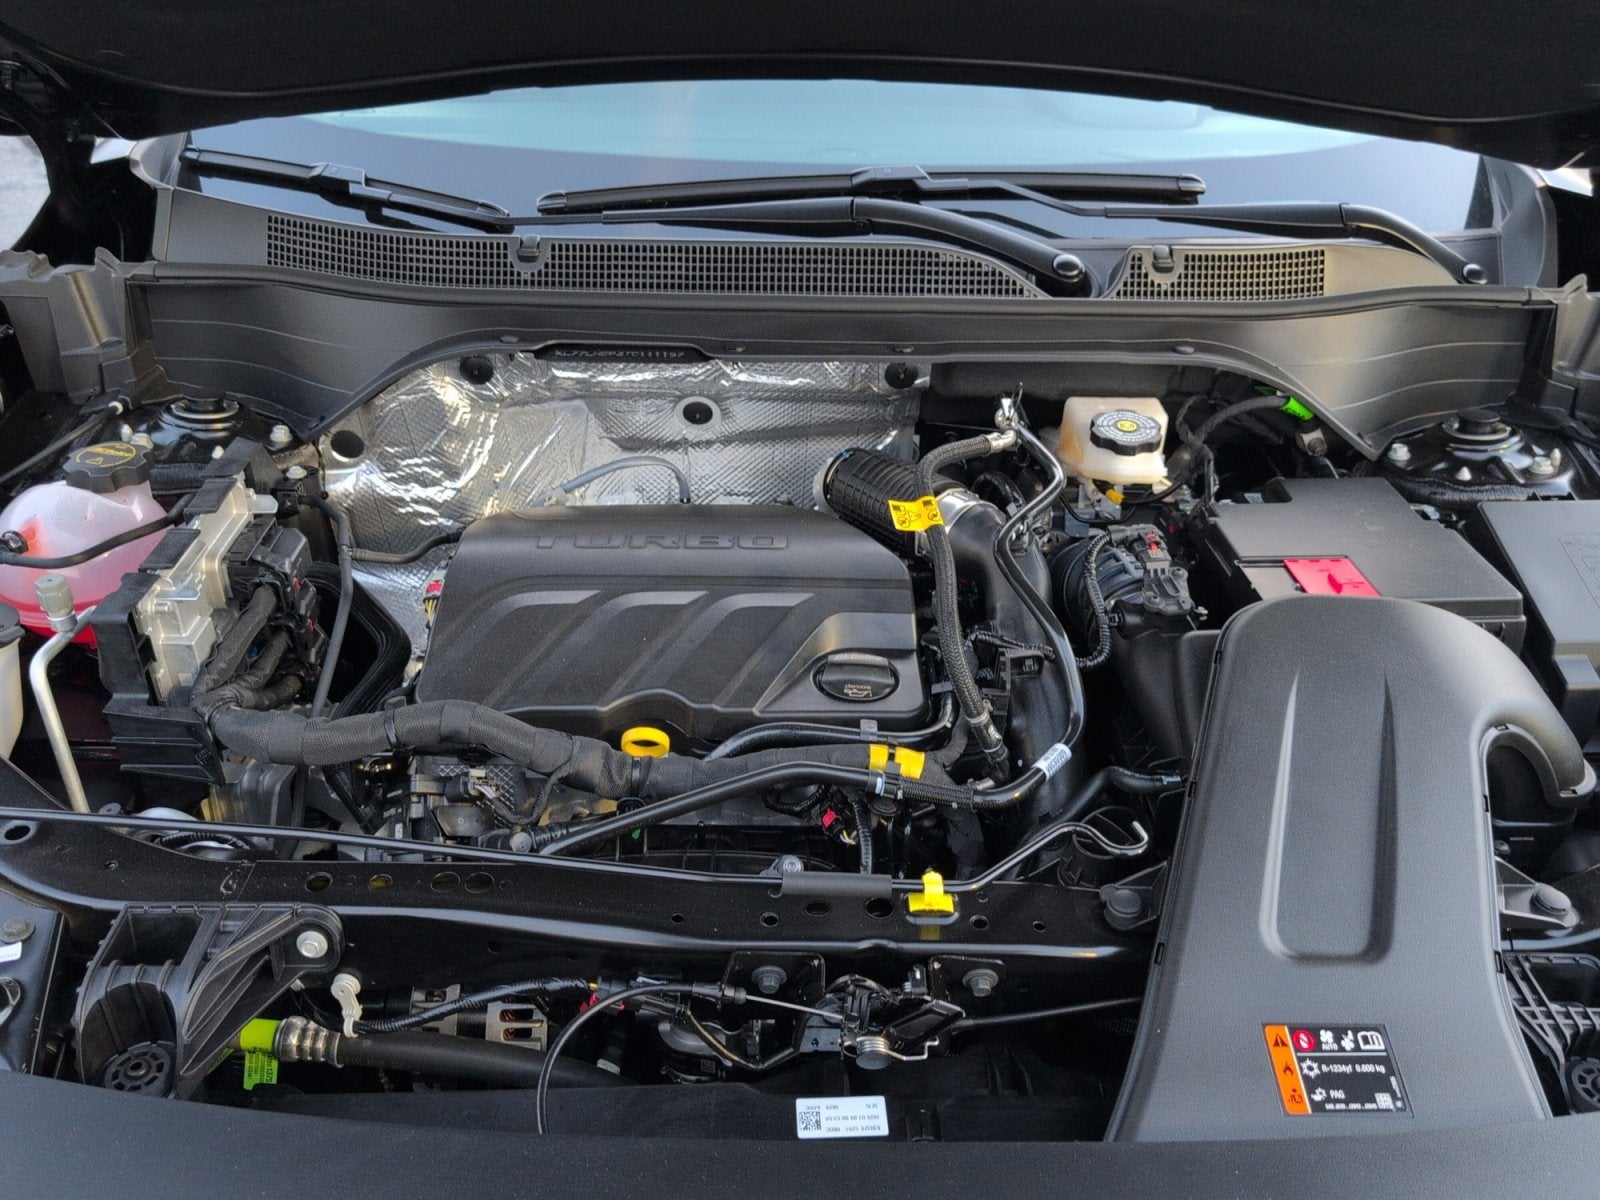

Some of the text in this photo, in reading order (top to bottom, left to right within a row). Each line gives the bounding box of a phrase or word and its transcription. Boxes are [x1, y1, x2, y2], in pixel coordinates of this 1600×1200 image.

[536, 534, 789, 550] TURBO
[1321, 1043, 1338, 1051] AUTO
[1321, 1063, 1352, 1075] R-1234yf
[1375, 1064, 1386, 1074] kg
[1329, 1089, 1345, 1099] PAG
